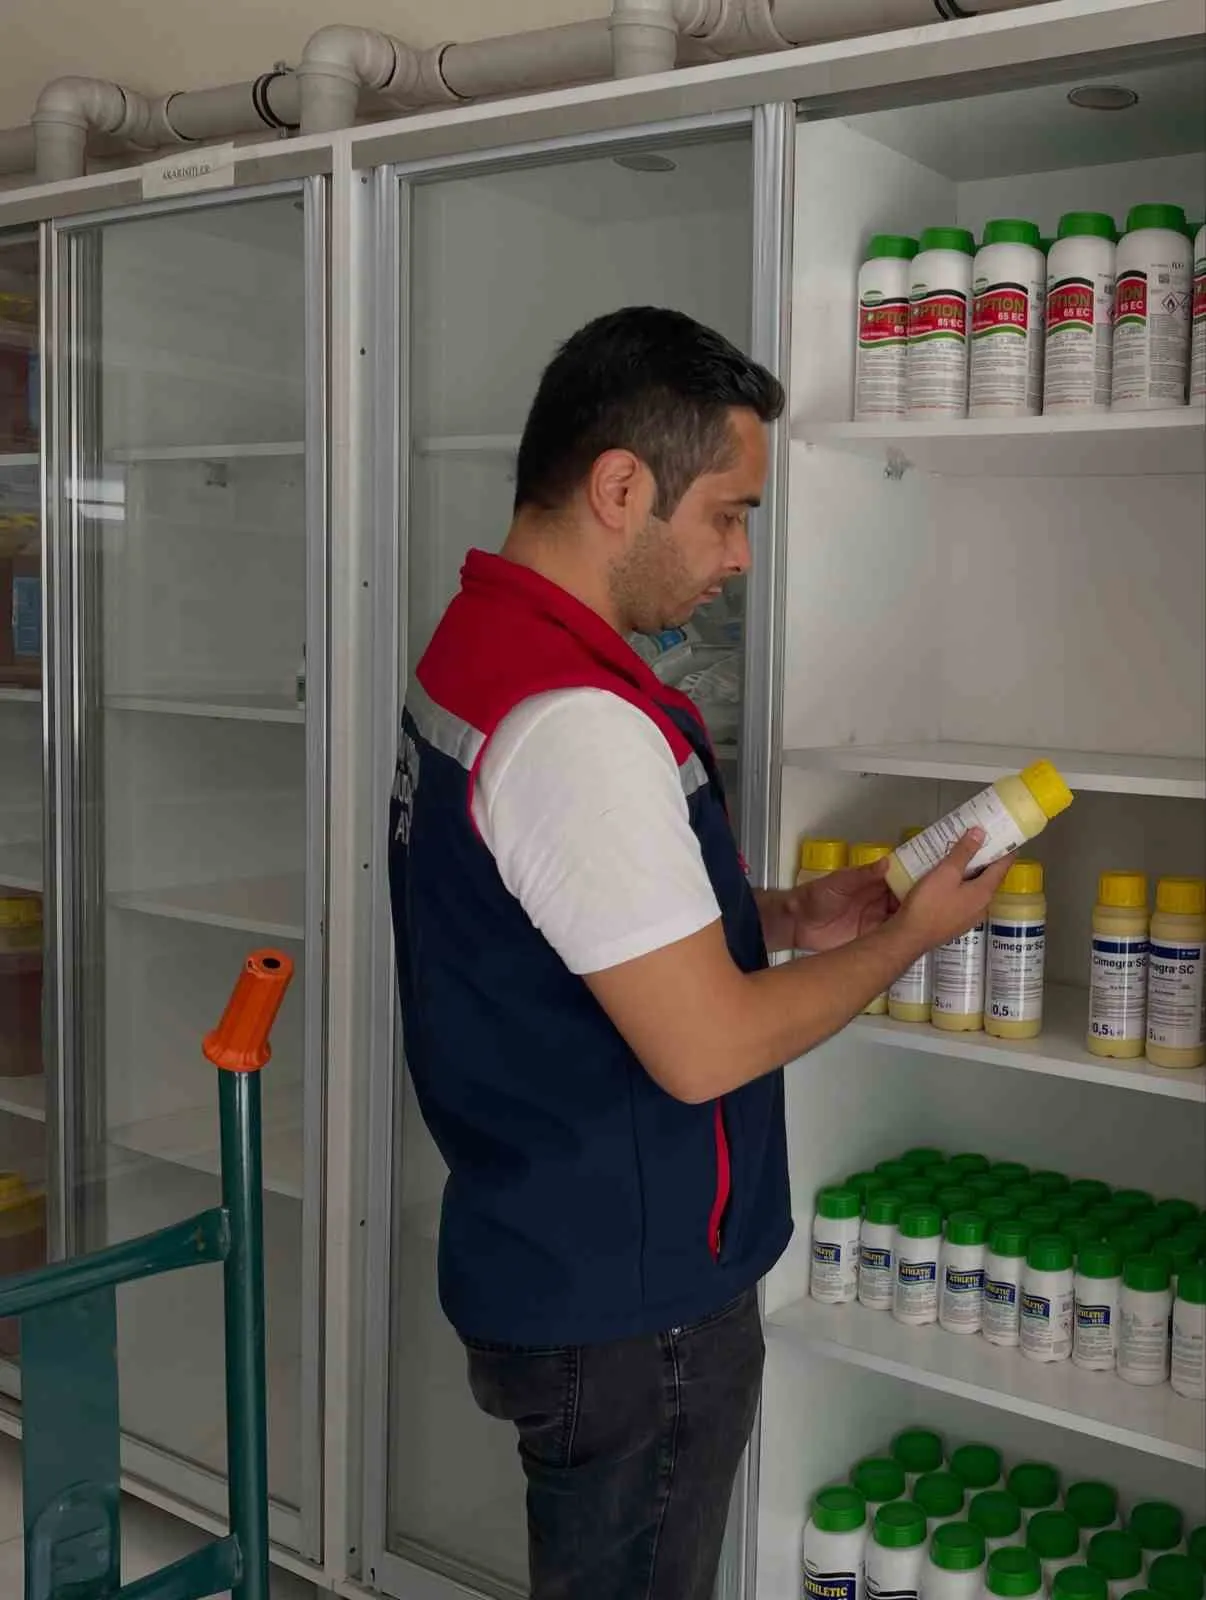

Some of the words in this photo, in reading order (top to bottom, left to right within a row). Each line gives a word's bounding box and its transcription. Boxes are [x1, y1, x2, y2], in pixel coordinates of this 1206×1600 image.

[1130, 301, 1144, 311] EC
[997, 312, 1009, 321] 65
[1011, 312, 1025, 322] EC
[1076, 308, 1090, 317] EC
[992, 940, 1032, 953] Cimegra
[1092, 956, 1133, 970] Cimegra
[1178, 964, 1195, 975] SC
[992, 1003, 1009, 1017] 0,5
[1092, 1022, 1109, 1036] 0,5
